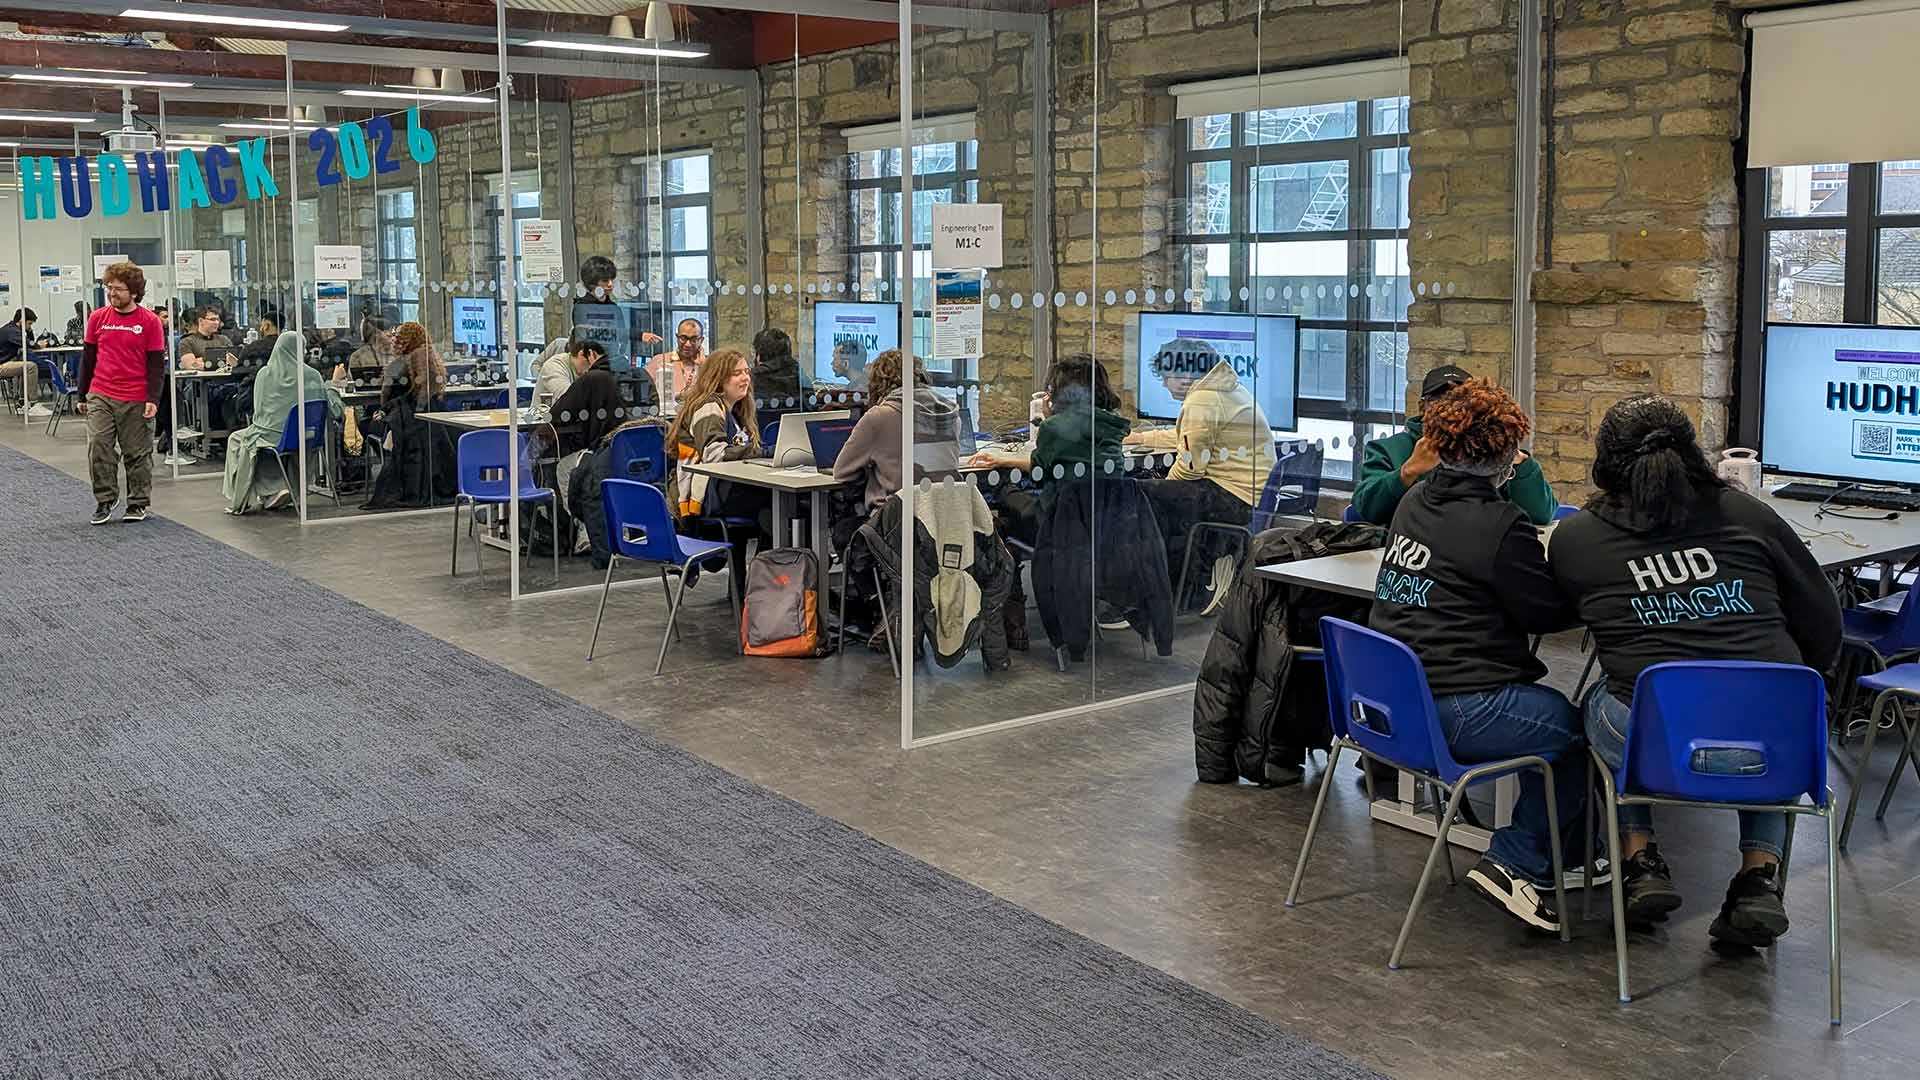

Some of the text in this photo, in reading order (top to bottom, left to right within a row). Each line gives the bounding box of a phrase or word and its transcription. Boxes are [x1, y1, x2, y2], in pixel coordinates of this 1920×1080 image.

[20, 105, 437, 220] HUDHACK 2026
[941, 224, 977, 233] Engineering
[955, 237, 982, 249] M1-C
[1858, 367, 1920, 382] WELCOM
[1827, 381, 1920, 416] HUDH
[1627, 547, 1718, 591] HUD
[1630, 579, 1755, 625] HACK
